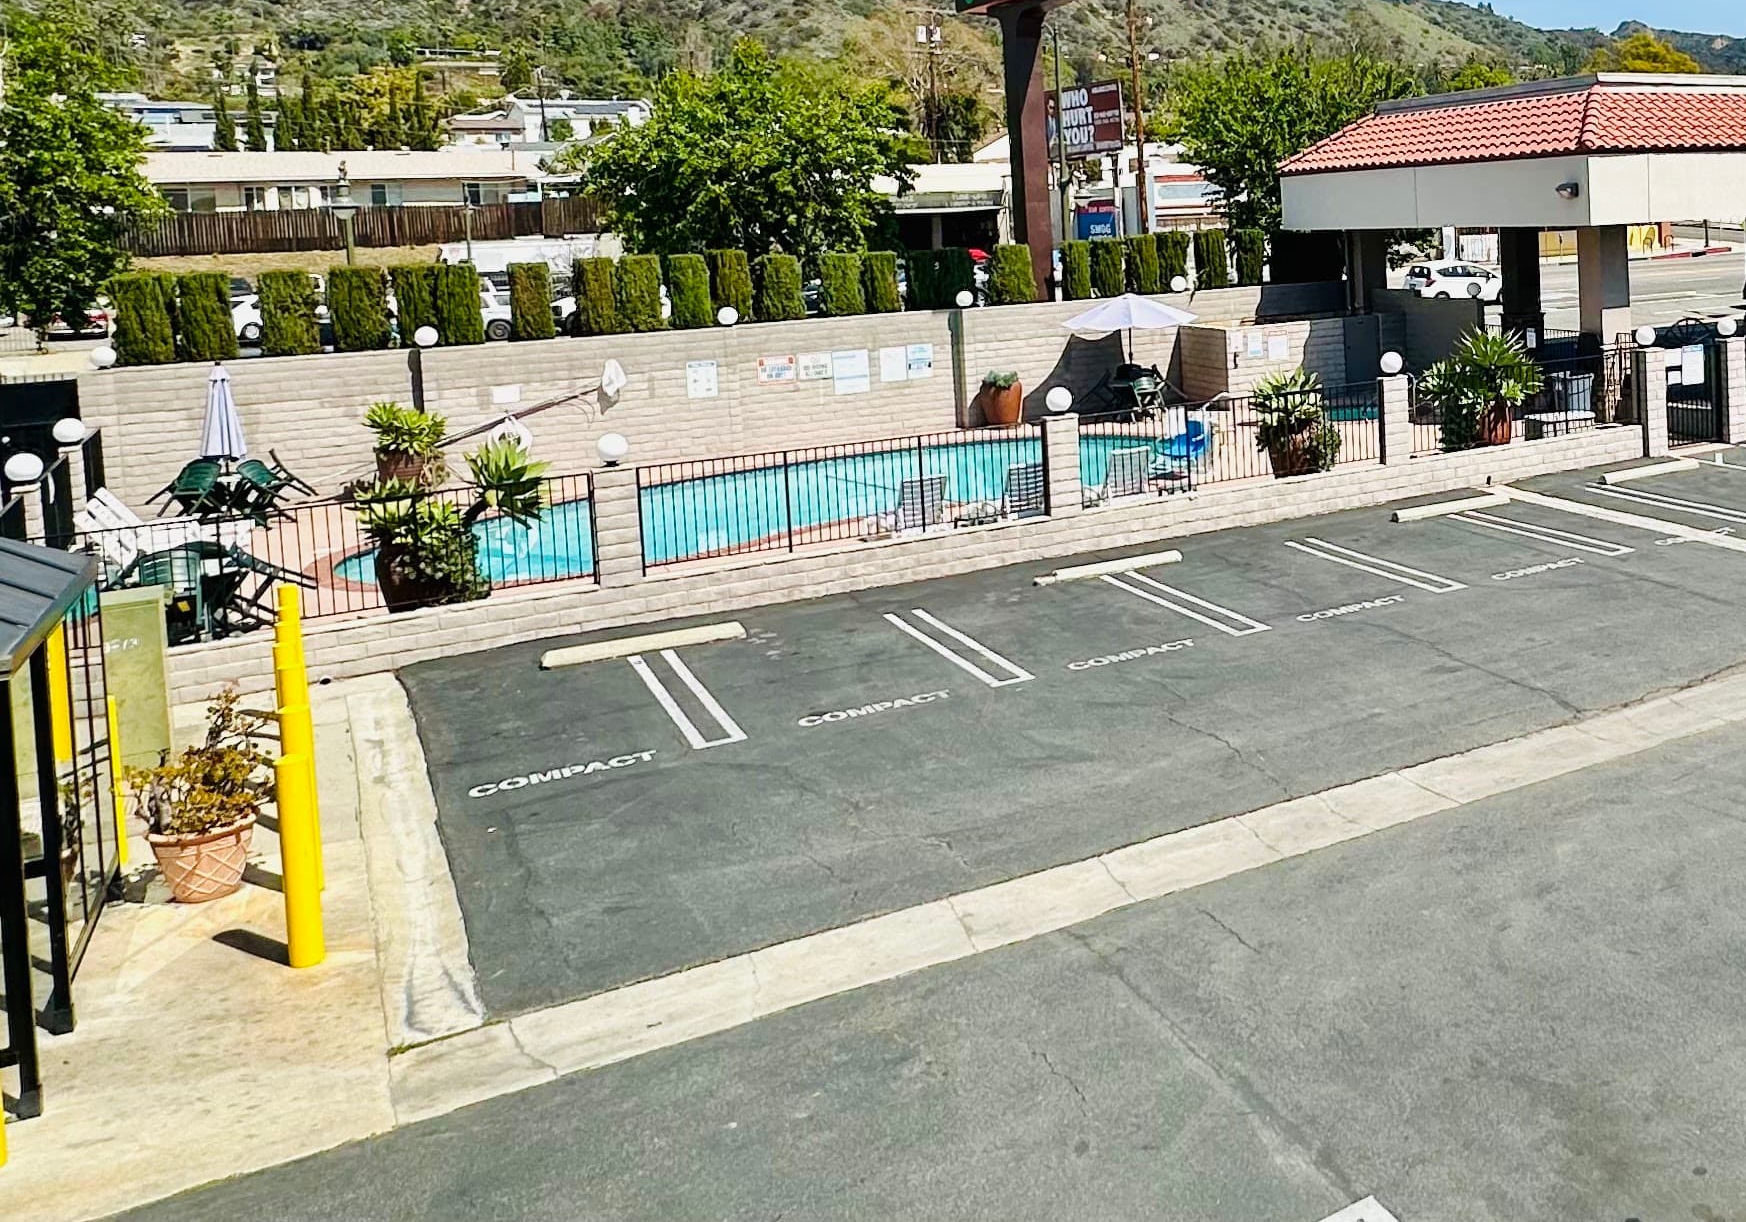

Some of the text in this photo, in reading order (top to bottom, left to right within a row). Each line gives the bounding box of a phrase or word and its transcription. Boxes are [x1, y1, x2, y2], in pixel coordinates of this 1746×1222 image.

[1062, 88, 1089, 109] WHO
[1062, 106, 1093, 128] HURT
[1063, 124, 1095, 145] YOU?
[1491, 557, 1584, 580] COMPACT
[1296, 595, 1405, 622] COMPACT
[1067, 638, 1194, 671] COMPACT
[798, 689, 950, 727] COMPACT
[468, 750, 657, 798] COMPACT
